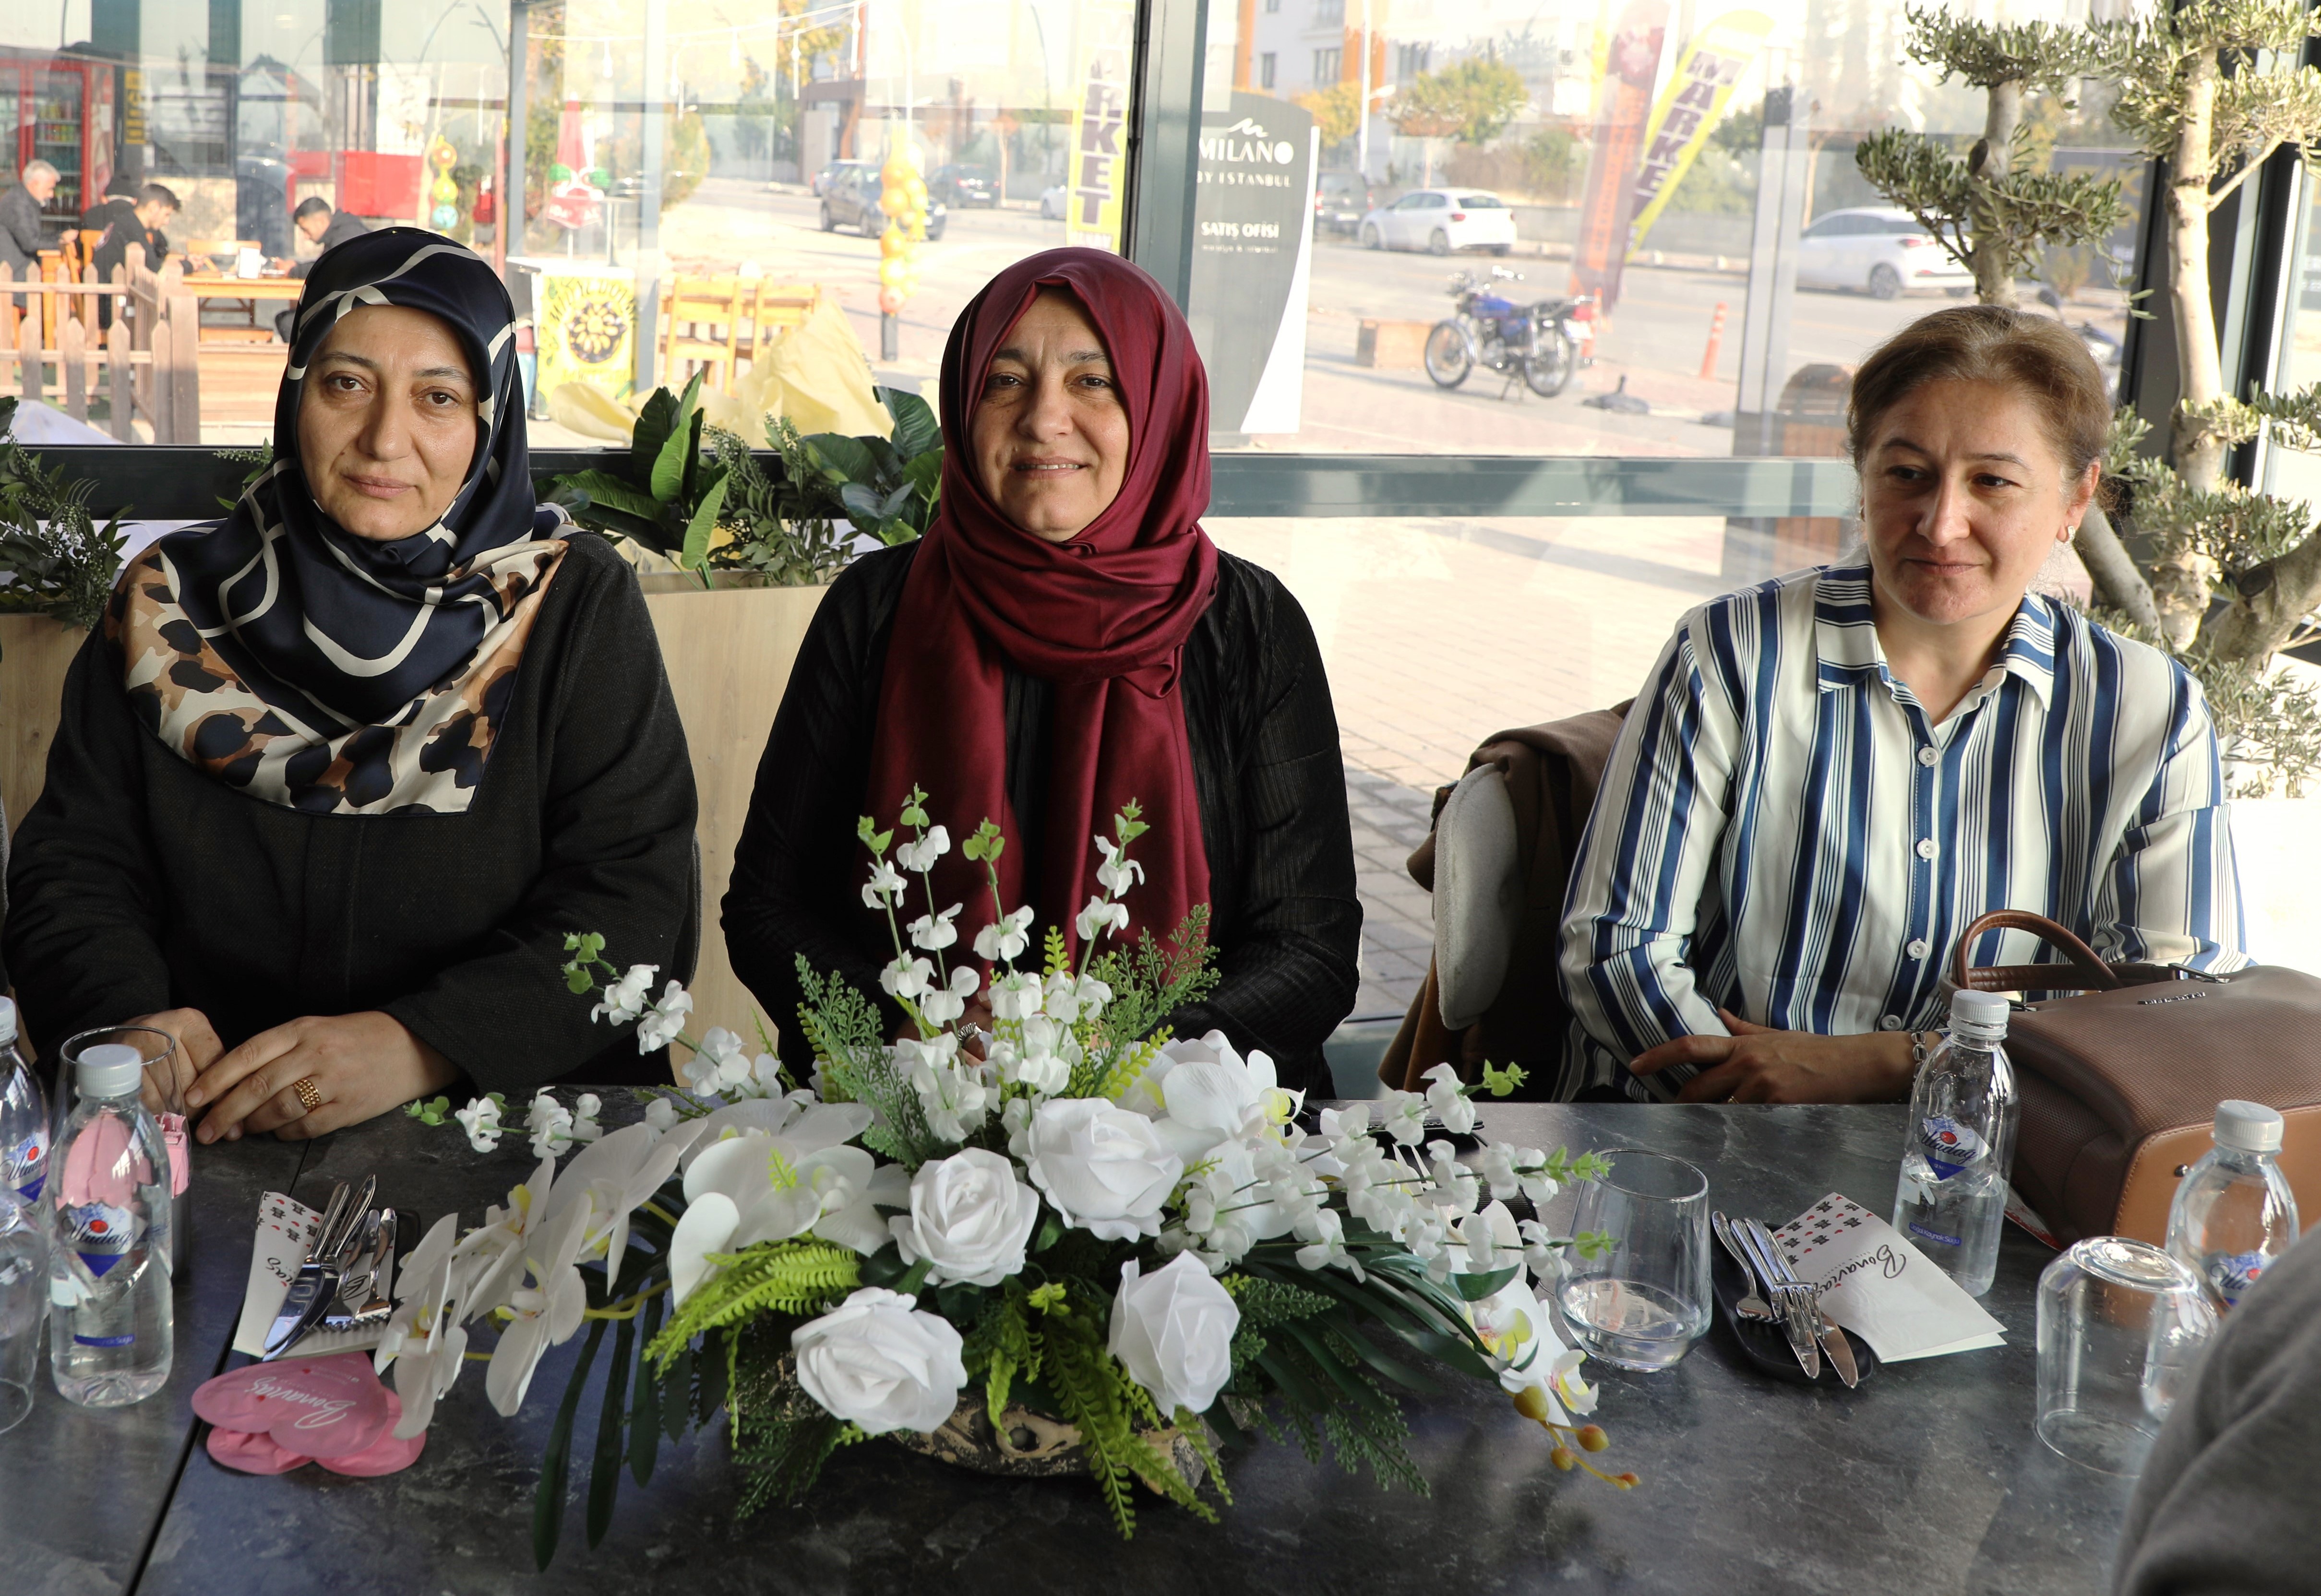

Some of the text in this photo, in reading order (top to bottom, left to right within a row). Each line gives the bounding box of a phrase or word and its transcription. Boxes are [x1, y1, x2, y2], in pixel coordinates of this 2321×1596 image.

[1199, 137, 1294, 165] MILANO
[1201, 220, 1280, 240] SATIŞ OFİSİ
[1918, 1123, 1978, 1165] Uludağ
[1944, 1236, 1960, 1245] Suyu
